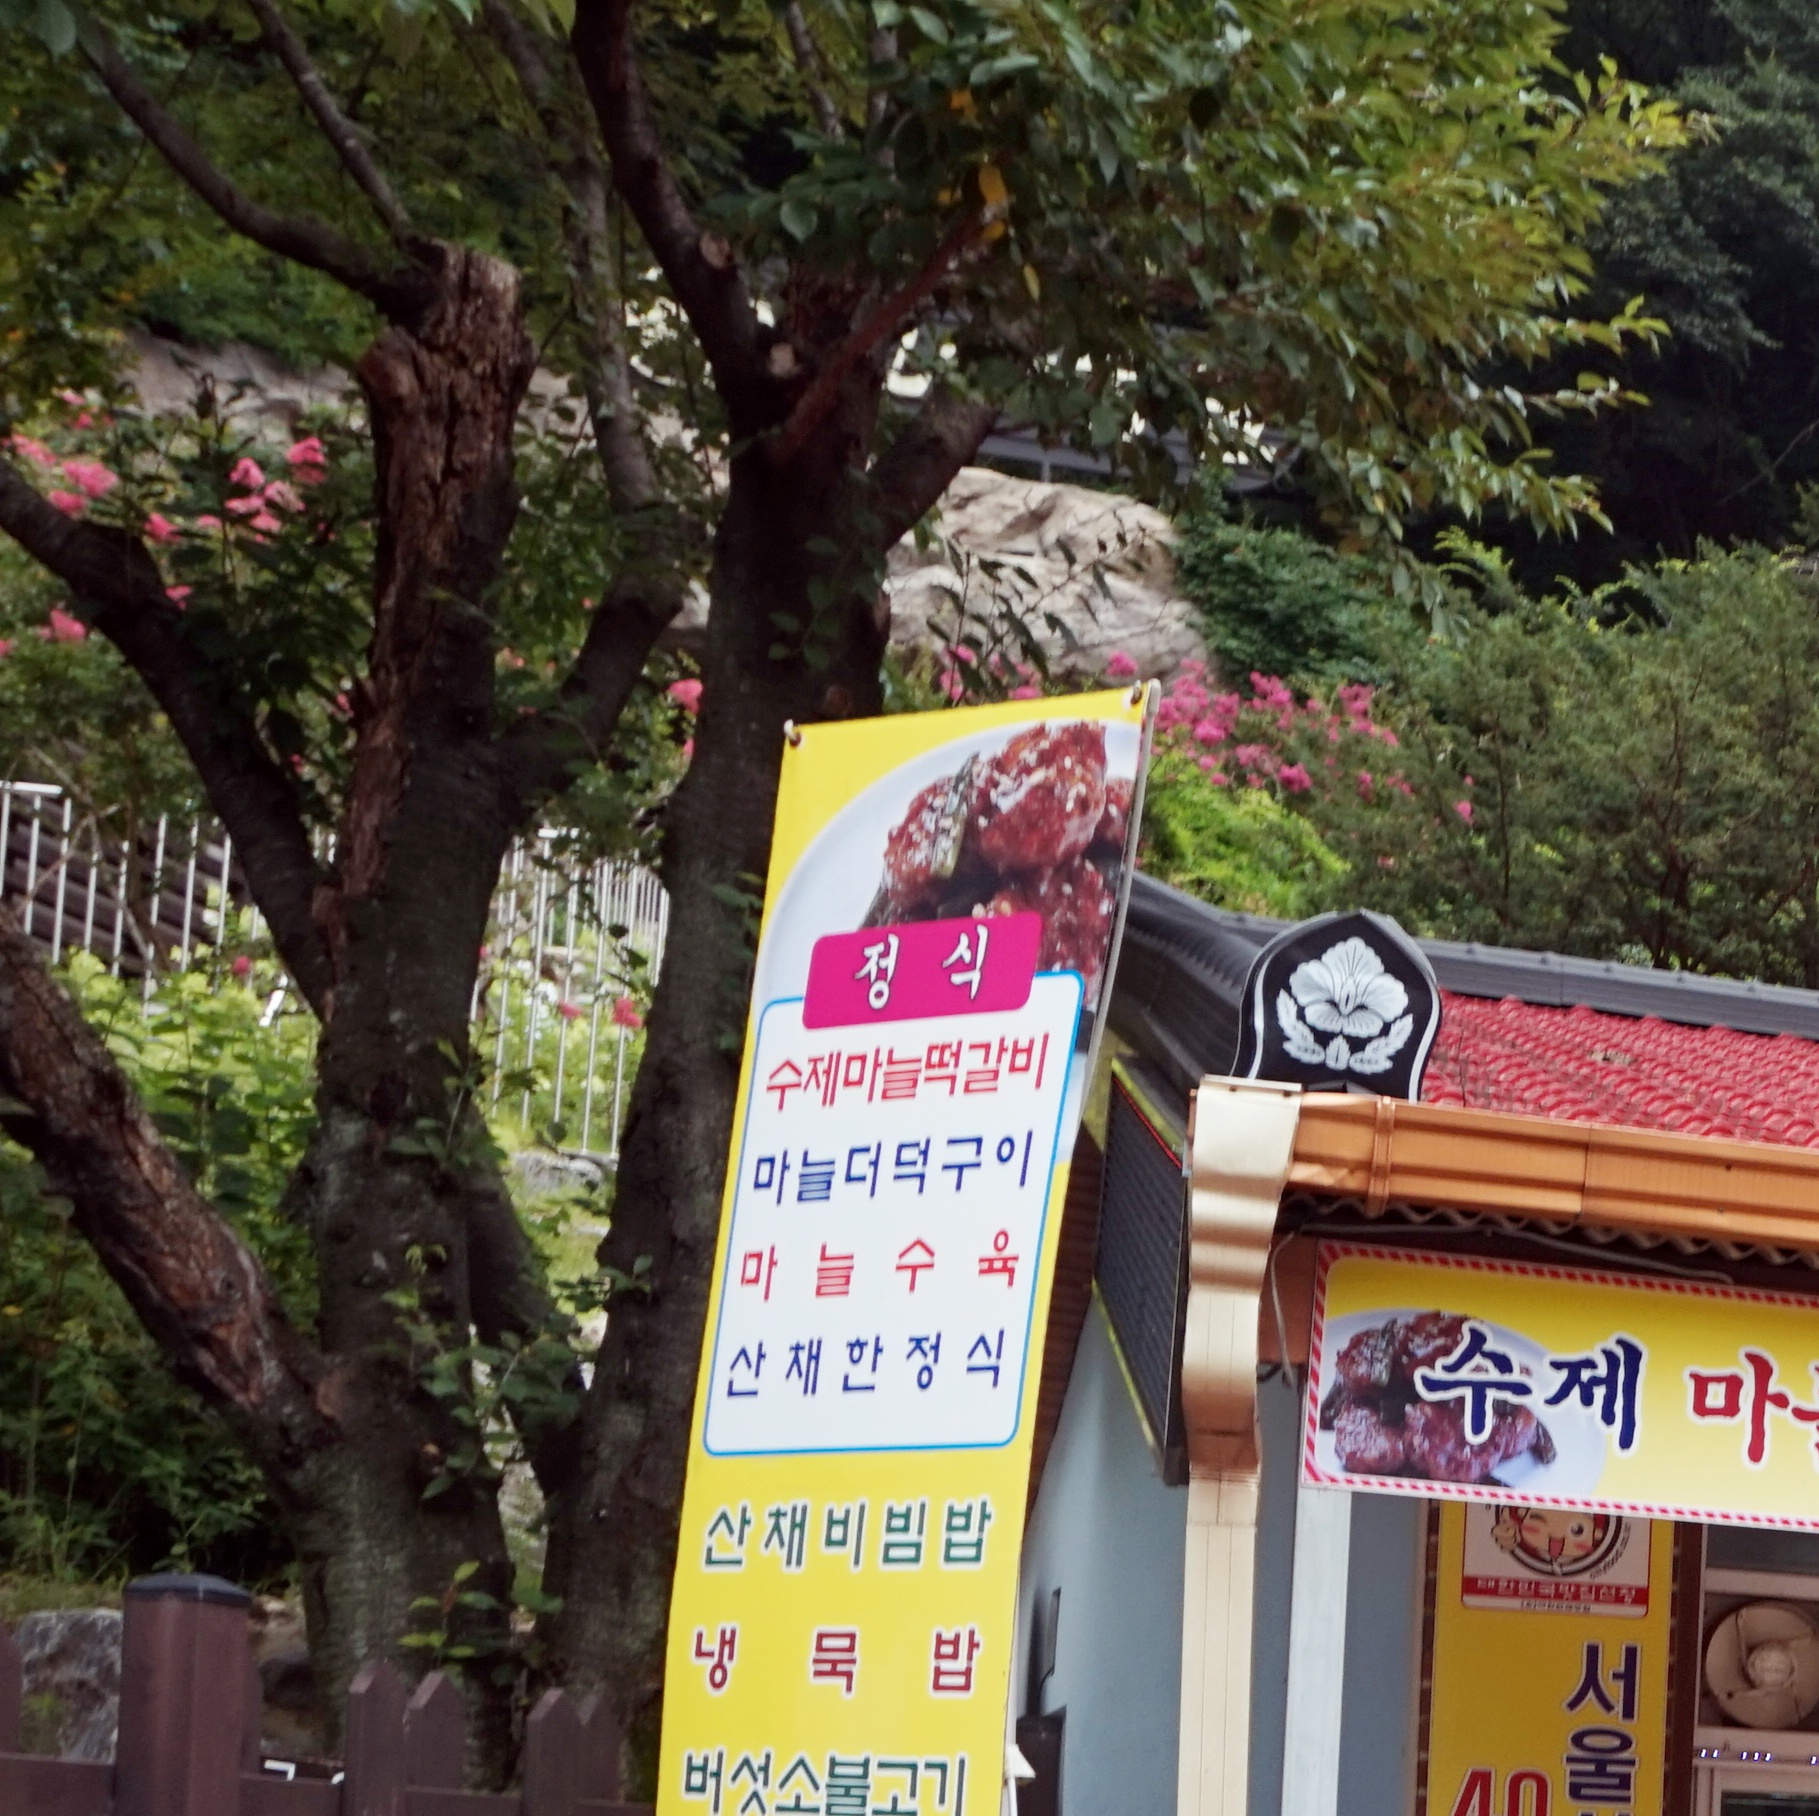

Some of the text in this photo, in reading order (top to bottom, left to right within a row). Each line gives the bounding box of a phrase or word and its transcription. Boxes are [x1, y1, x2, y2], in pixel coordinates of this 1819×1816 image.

[765, 1032, 1050, 1111] 수제마늘떡갈비
[753, 1130, 1035, 1204] 마늘더덕구이
[726, 1329, 1006, 1399] 산채한정식
[1417, 1320, 1646, 1451] 수제
[704, 1497, 994, 1570] 산채비빔밥
